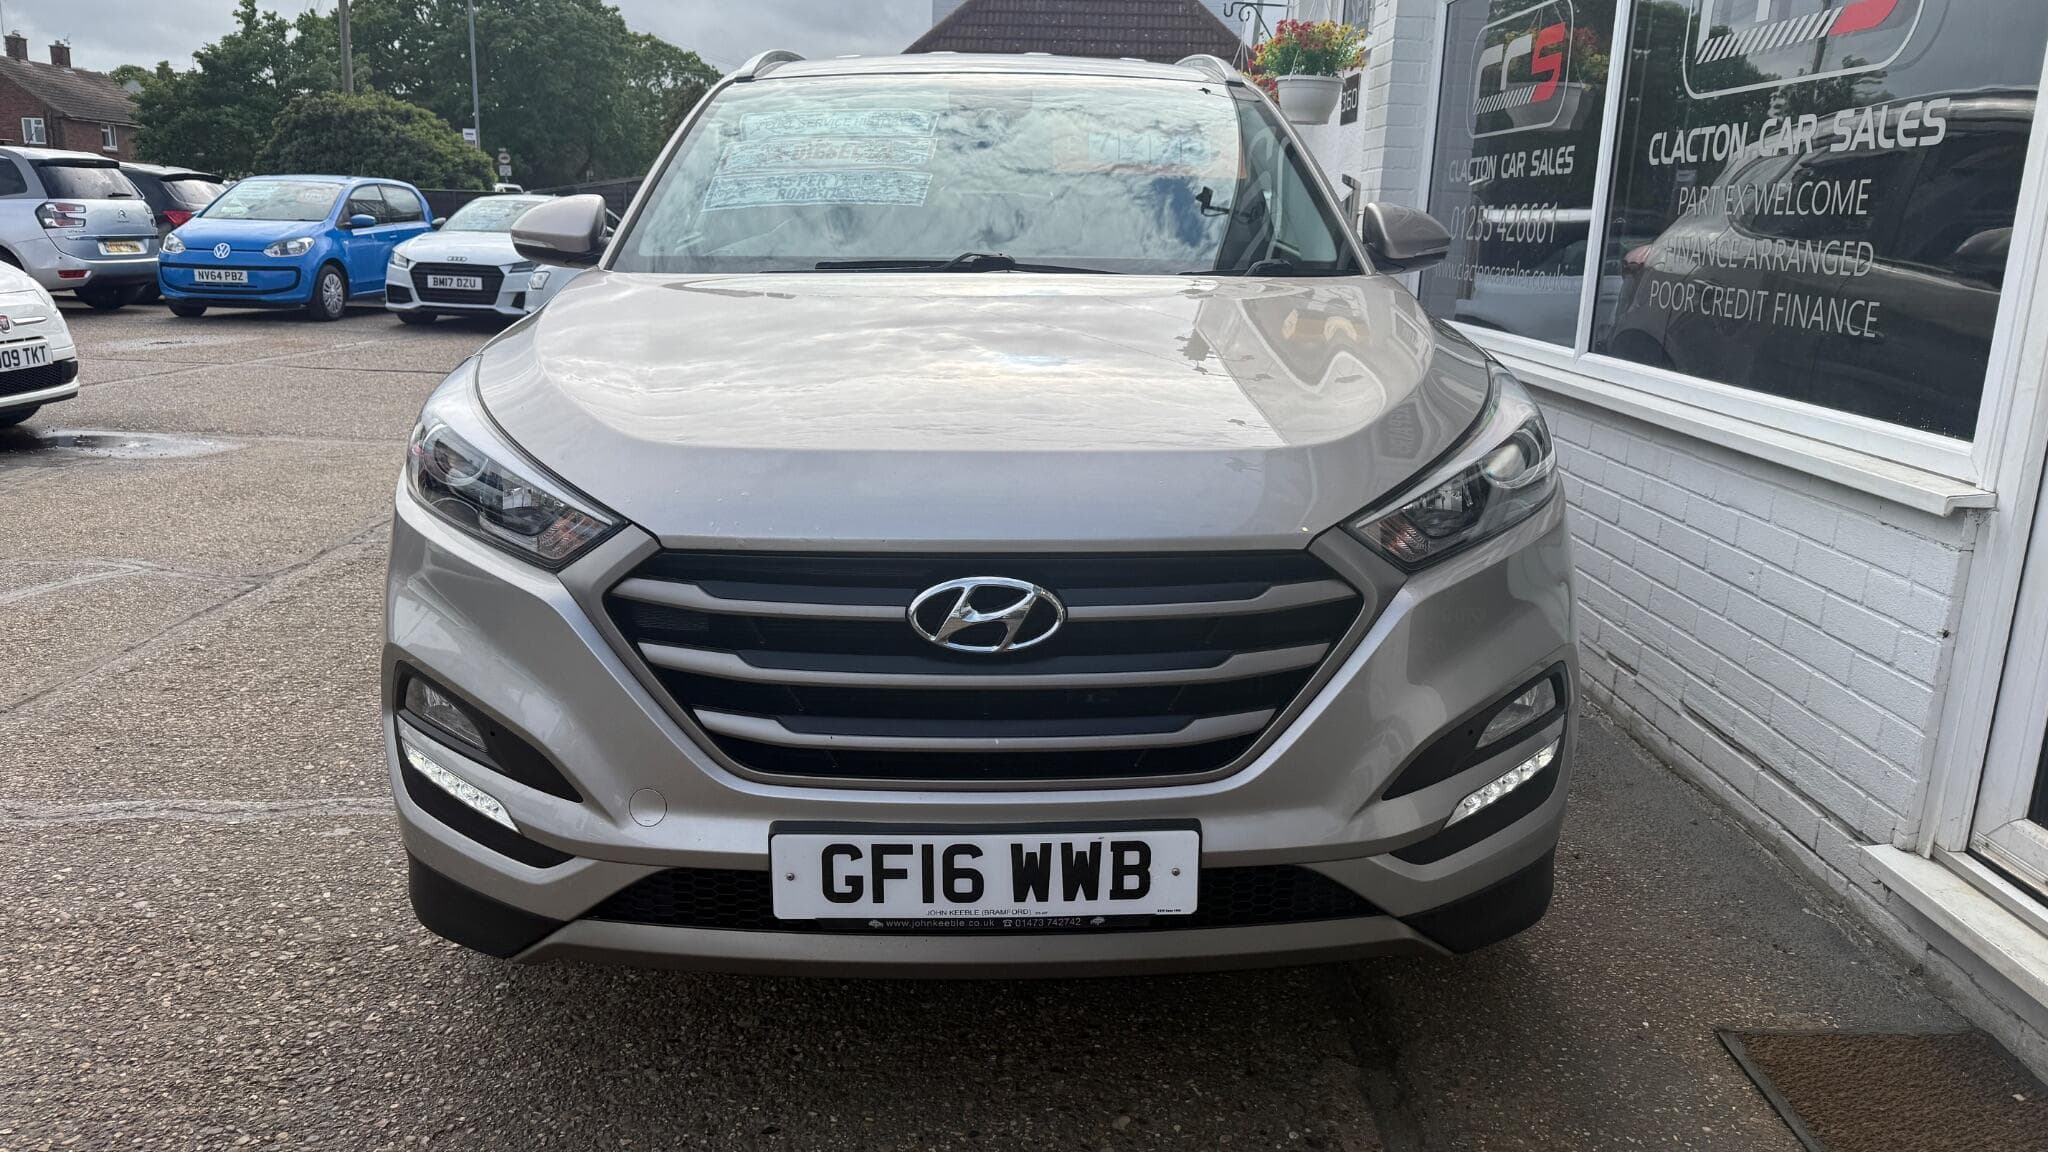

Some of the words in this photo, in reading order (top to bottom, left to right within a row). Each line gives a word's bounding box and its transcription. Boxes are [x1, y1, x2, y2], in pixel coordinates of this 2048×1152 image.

[1341, 88, 1358, 112] 360
[1648, 121, 1748, 166] CLACTON
[1757, 113, 1818, 158] CAR
[1829, 98, 1951, 153] SALES
[1448, 155, 1497, 183] CLACTON
[1501, 151, 1526, 179] CAR
[1530, 145, 1576, 177] SALES
[1677, 185, 1721, 216] PART
[1724, 184, 1749, 216] EX
[1753, 178, 1872, 216] WELCOME
[1450, 204, 1495, 241] 01255
[1497, 201, 1558, 243] 426661
[198, 270, 222, 281] NV64
[225, 271, 244, 281] PBZ
[1664, 236, 1740, 269] FINANCE
[1743, 237, 1874, 277] ARRANGED
[432, 276, 454, 287] BM17
[1650, 280, 1696, 313] POOR
[1700, 284, 1769, 323] CREDIT
[1772, 291, 1880, 338] FINANCE
[0, 349, 21, 369] 09
[22, 345, 46, 365] TKT
[821, 843, 985, 904] GF16
[1010, 840, 1152, 903] WWB
[926, 909, 948, 917] JOHN
[949, 909, 980, 917] KEEBLE
[1047, 917, 1081, 927] 742742
